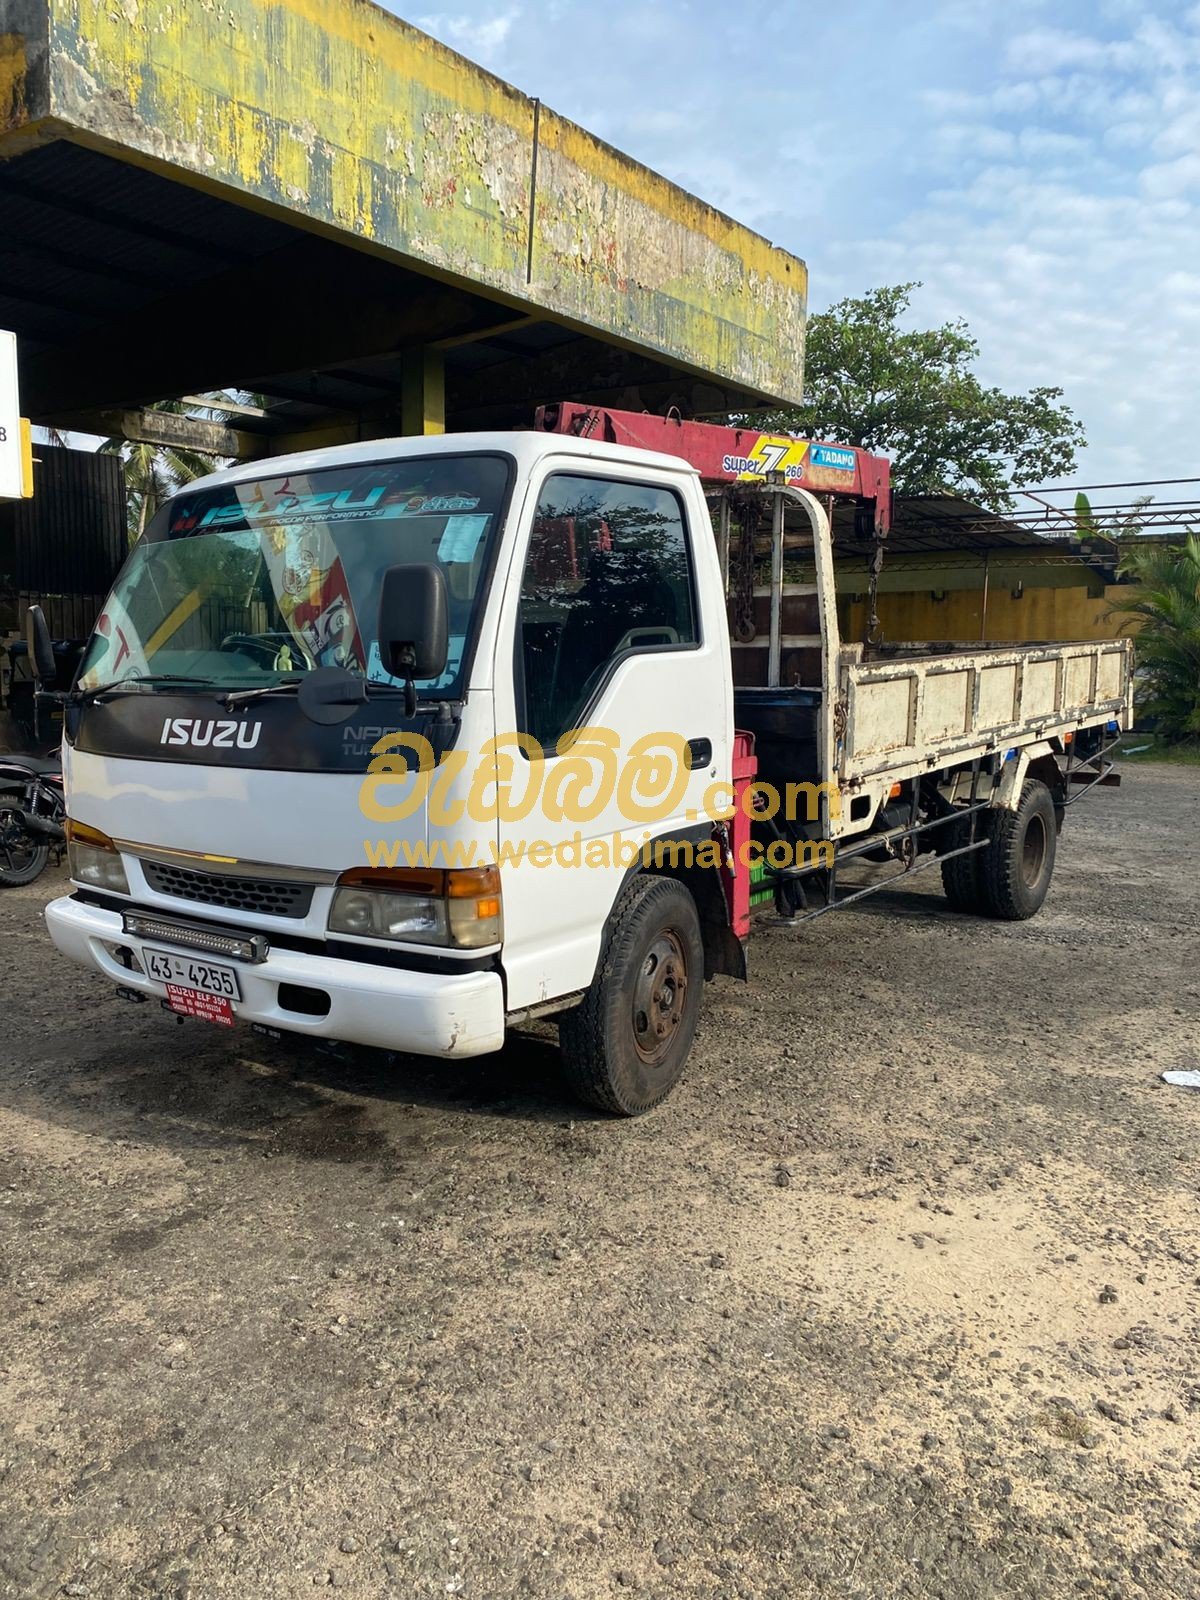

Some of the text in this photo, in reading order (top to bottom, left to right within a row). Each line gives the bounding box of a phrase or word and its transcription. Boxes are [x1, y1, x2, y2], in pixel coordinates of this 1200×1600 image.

[724, 455, 759, 475] super
[786, 465, 802, 478] 260
[160, 717, 262, 749] ISUZU
[167, 984, 195, 998] ISUZU
[196, 991, 211, 1002] ELF
[212, 995, 227, 1007] 350
